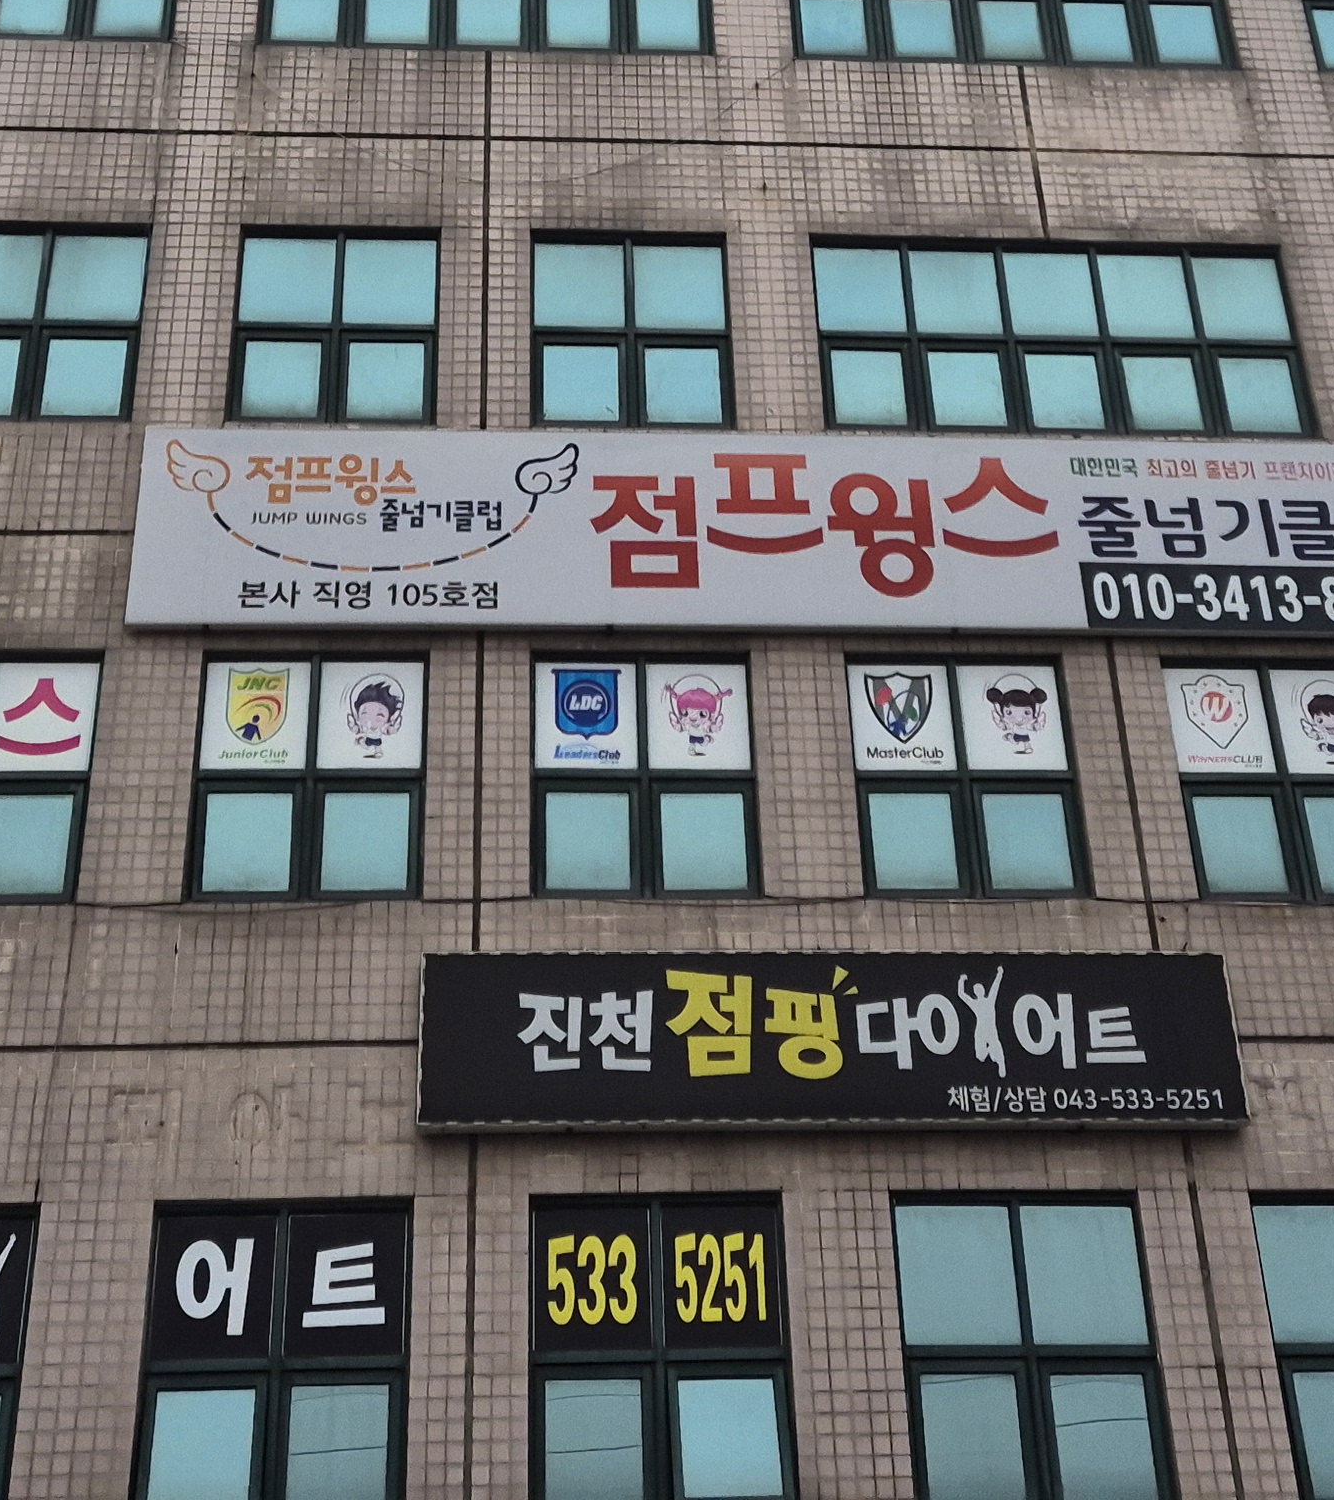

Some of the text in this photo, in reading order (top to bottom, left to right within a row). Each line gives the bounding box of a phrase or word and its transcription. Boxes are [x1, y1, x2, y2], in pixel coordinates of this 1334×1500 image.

[246, 453, 417, 505] 점프윙스
[1069, 456, 1139, 479] 대한민국
[1146, 458, 1198, 479] 최고의
[1204, 460, 1257, 481] 줄넘기
[249, 510, 367, 527] JUMP WINGS
[378, 498, 503, 533] 줄넘기클럽
[589, 451, 1060, 599] 점프윙스
[237, 581, 500, 610] 본사 직영 105호점
[237, 676, 283, 691] JNC
[569, 693, 604, 712] LDC
[517, 966, 1149, 1080] 진천 점핑 다이어트
[946, 1085, 1225, 1114] 체험/상담 043-533-5251
[546, 1234, 638, 1326] 533
[674, 1231, 768, 1324] 5251
